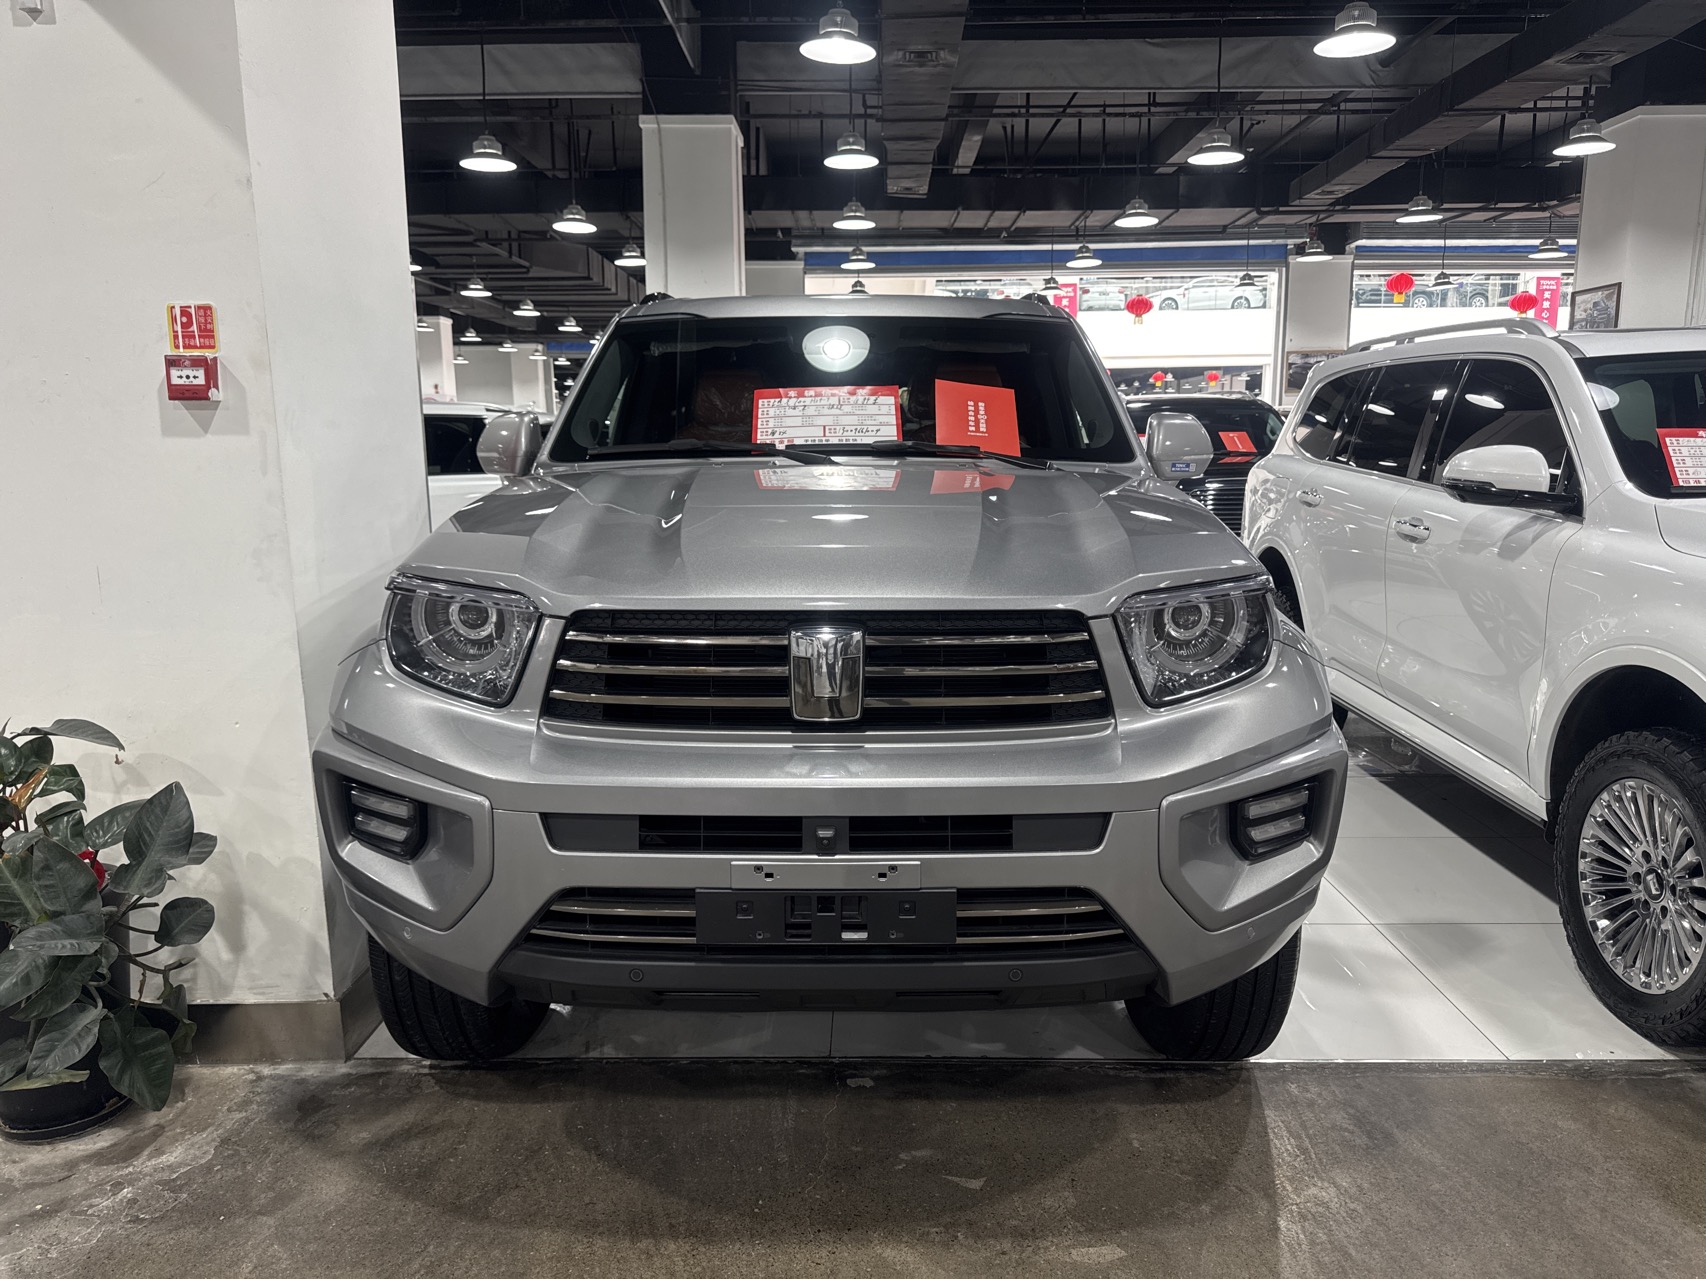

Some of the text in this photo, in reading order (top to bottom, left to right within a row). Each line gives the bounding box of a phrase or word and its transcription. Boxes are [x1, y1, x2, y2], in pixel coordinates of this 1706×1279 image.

[174, 338, 215, 346] 火手动警按钮
